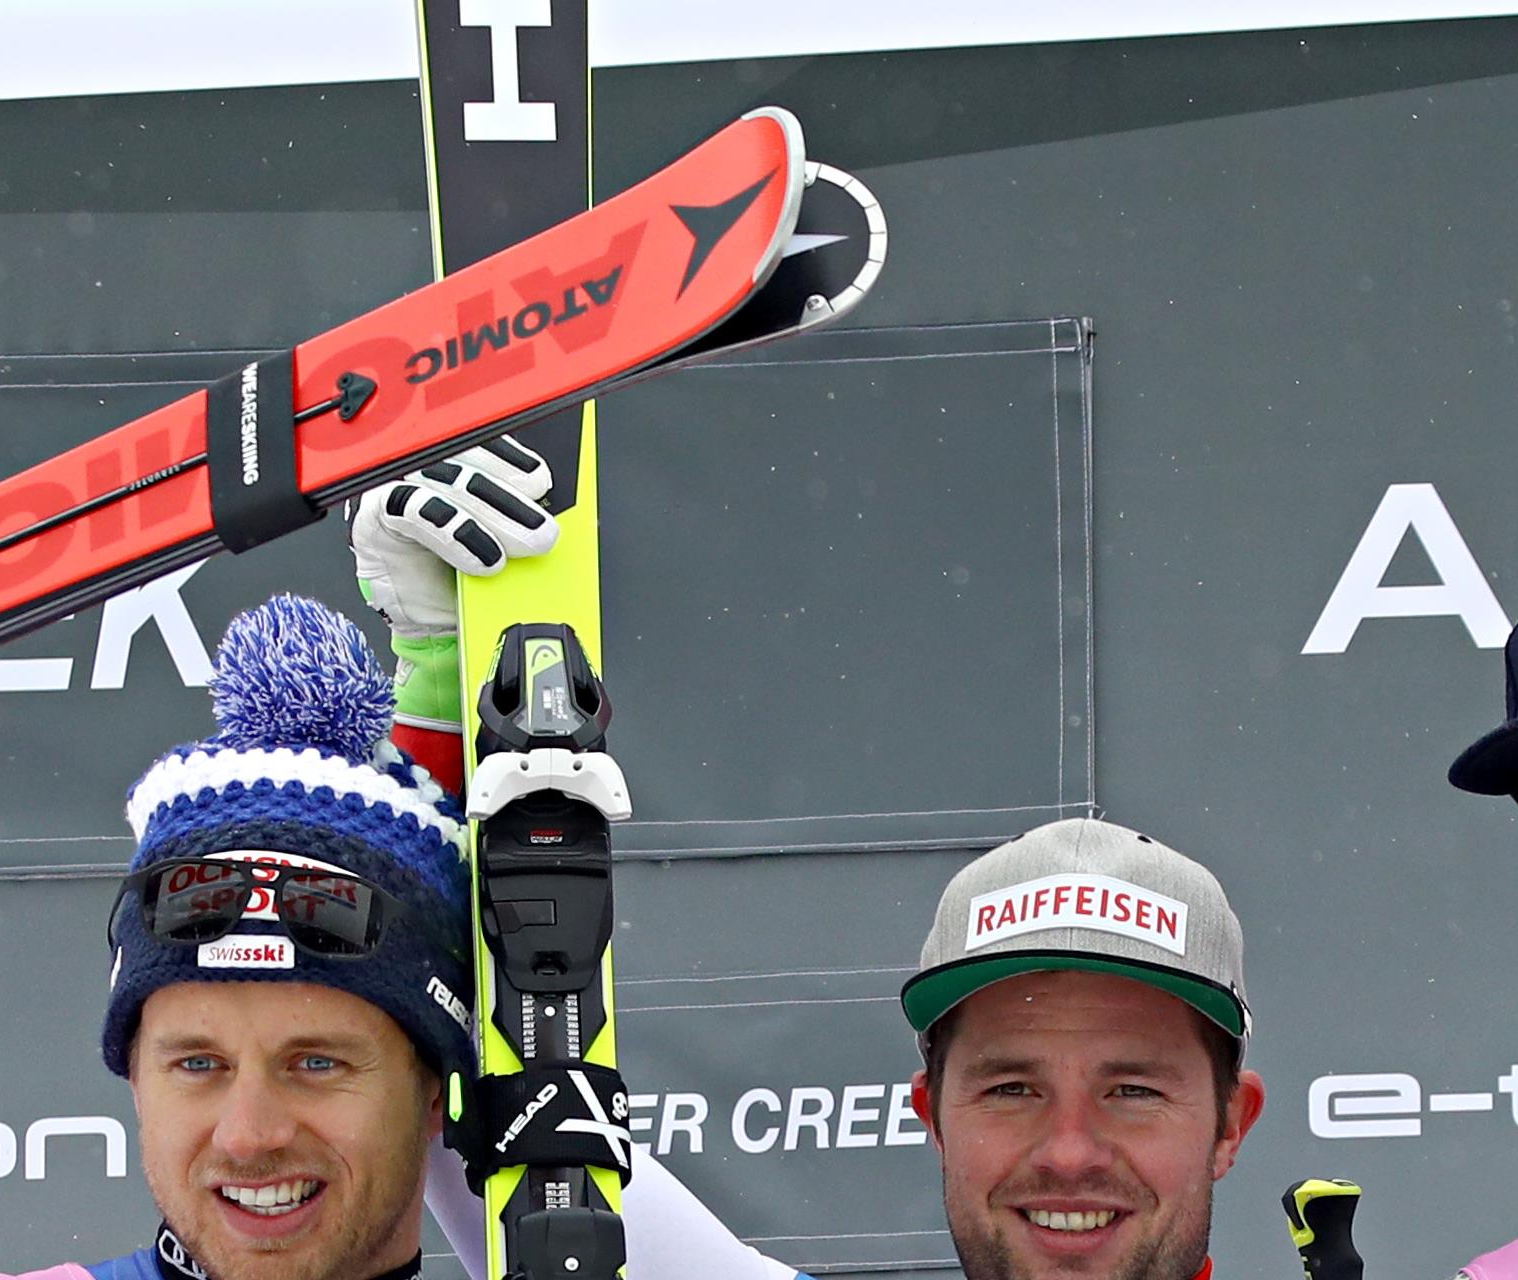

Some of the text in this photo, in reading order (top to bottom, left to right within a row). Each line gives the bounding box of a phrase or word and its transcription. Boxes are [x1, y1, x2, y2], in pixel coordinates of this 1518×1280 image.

[404, 264, 624, 385] ATOMIC
[975, 884, 1179, 942] RAIFFEISEN
[208, 944, 285, 962] swissski
[495, 1083, 559, 1153] HEAD
[729, 1083, 931, 1155] CREE
